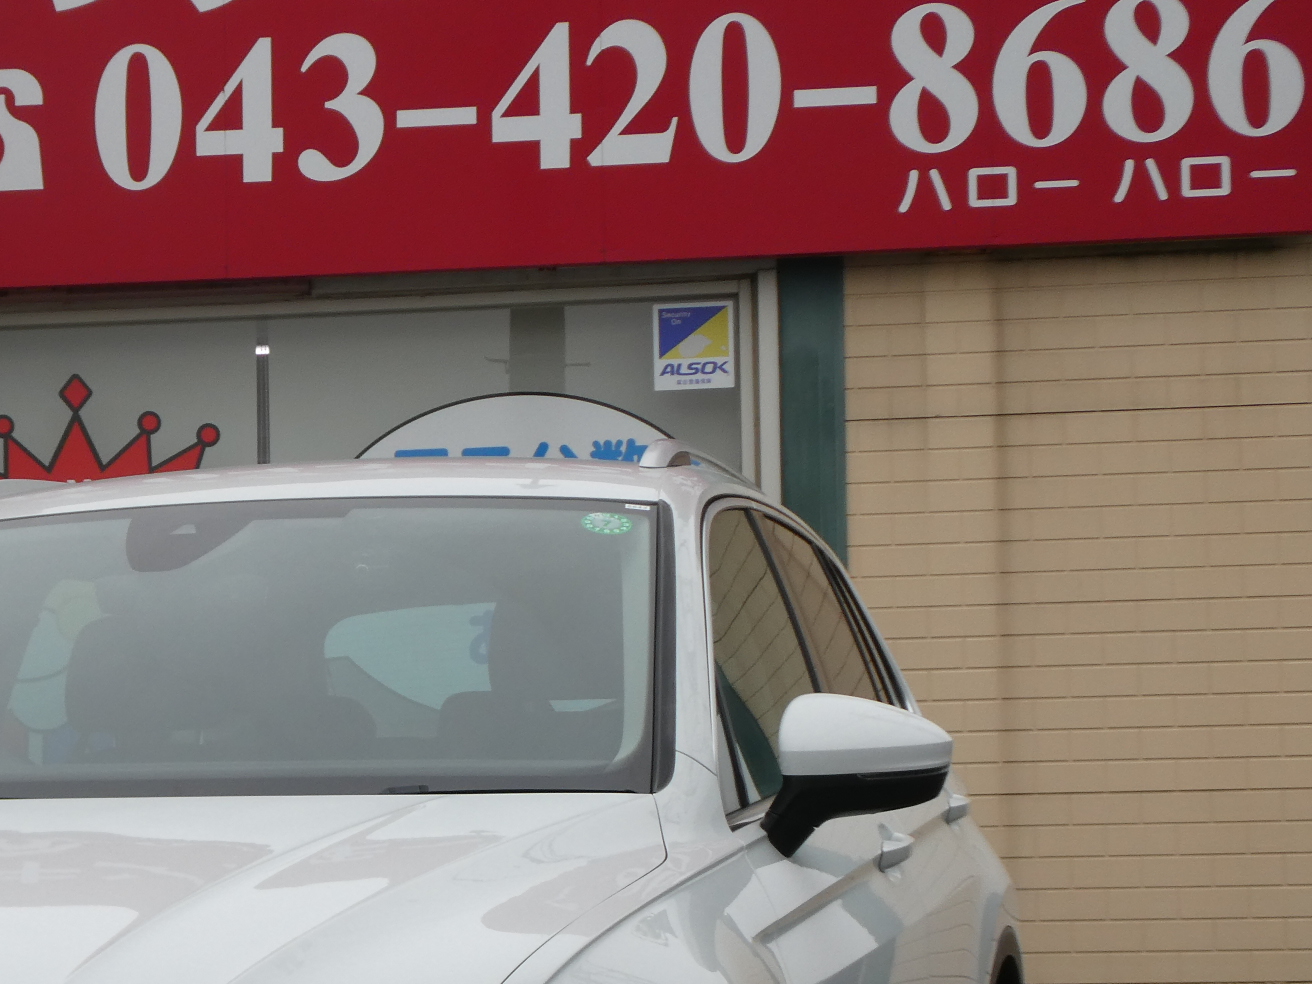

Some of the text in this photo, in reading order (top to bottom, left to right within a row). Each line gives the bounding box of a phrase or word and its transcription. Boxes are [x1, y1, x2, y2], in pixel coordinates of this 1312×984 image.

[94, 0, 1305, 191] 043-420-8686
[898, 155, 1297, 213] ハロー ハロー
[659, 361, 730, 376] ALSOK
